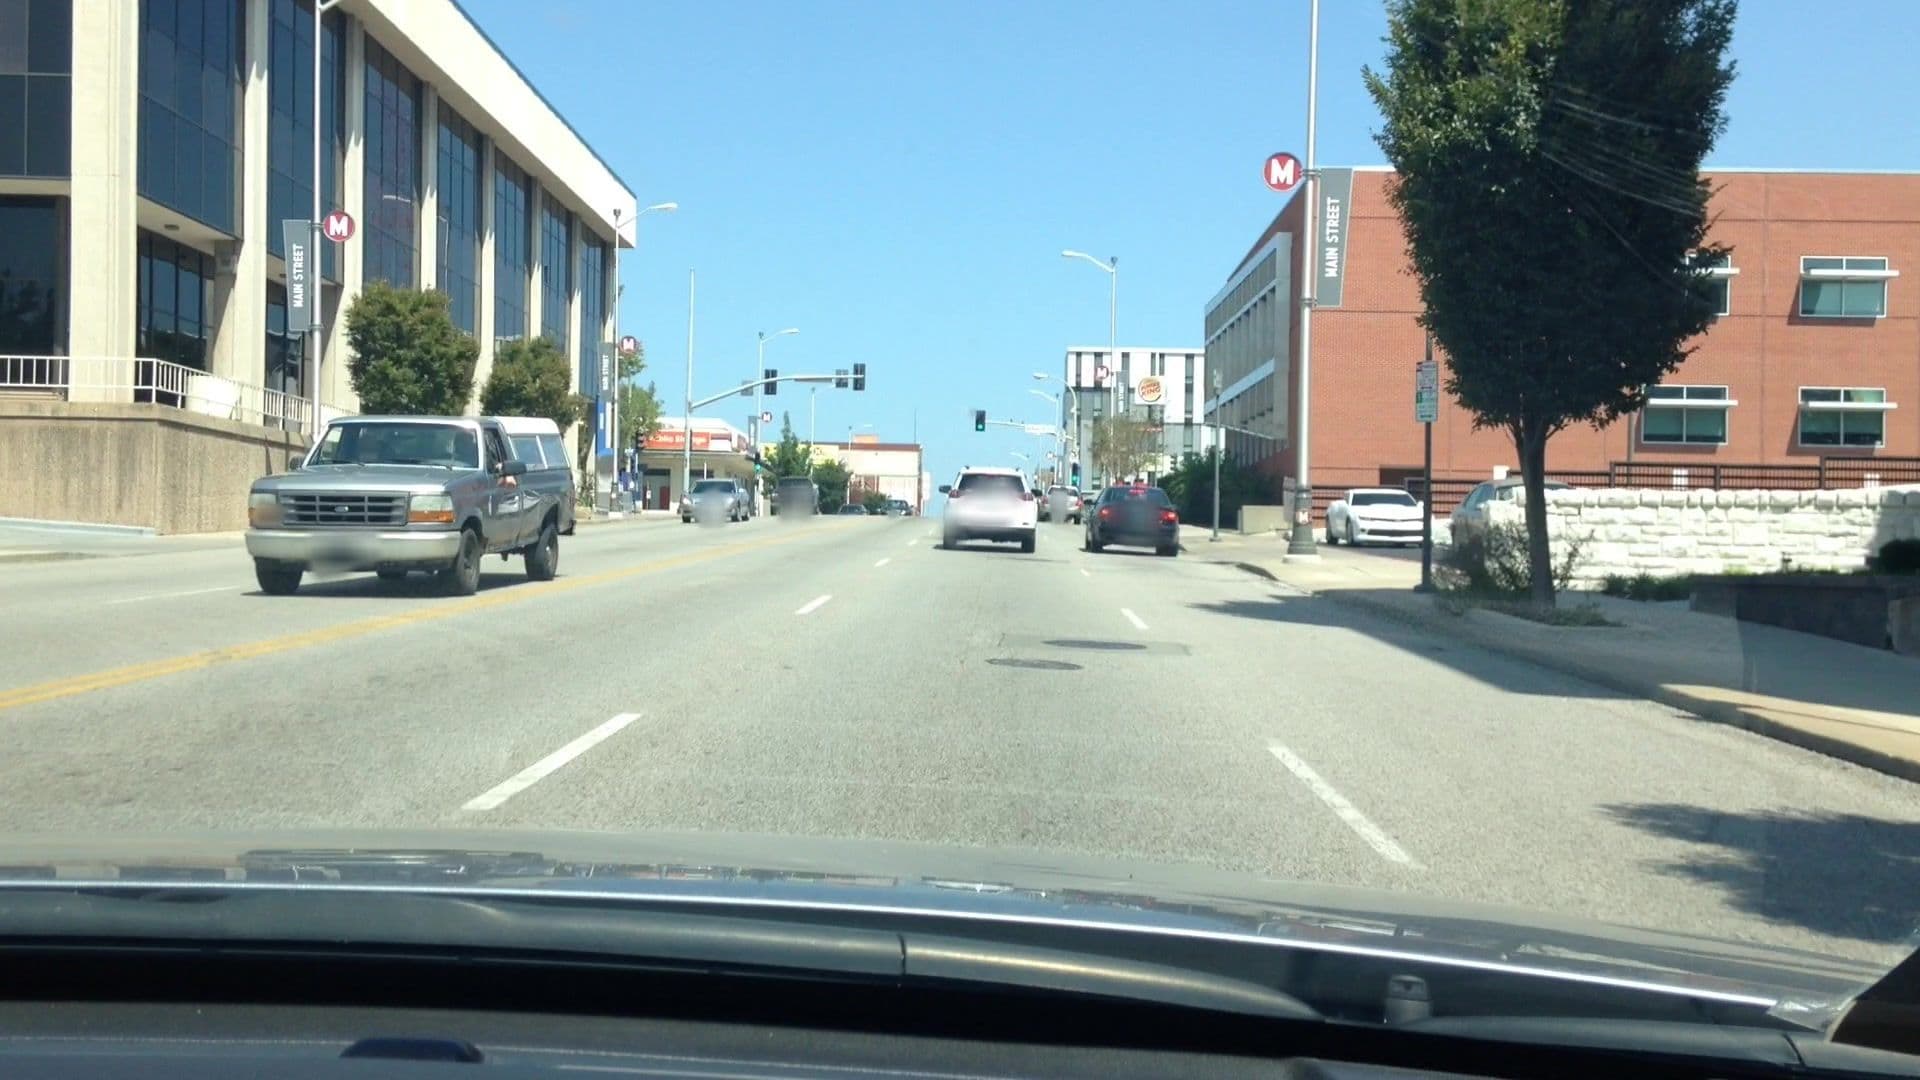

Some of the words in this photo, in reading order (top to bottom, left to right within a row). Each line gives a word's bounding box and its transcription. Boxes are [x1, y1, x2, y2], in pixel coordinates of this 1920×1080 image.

[1270, 158, 1295, 185] M
[329, 215, 349, 237] M
[1325, 196, 1340, 244] STREET
[292, 243, 304, 281] STREET
[1324, 248, 1339, 278] MAIN
[293, 283, 304, 308] MAIN
[622, 338, 635, 351] M
